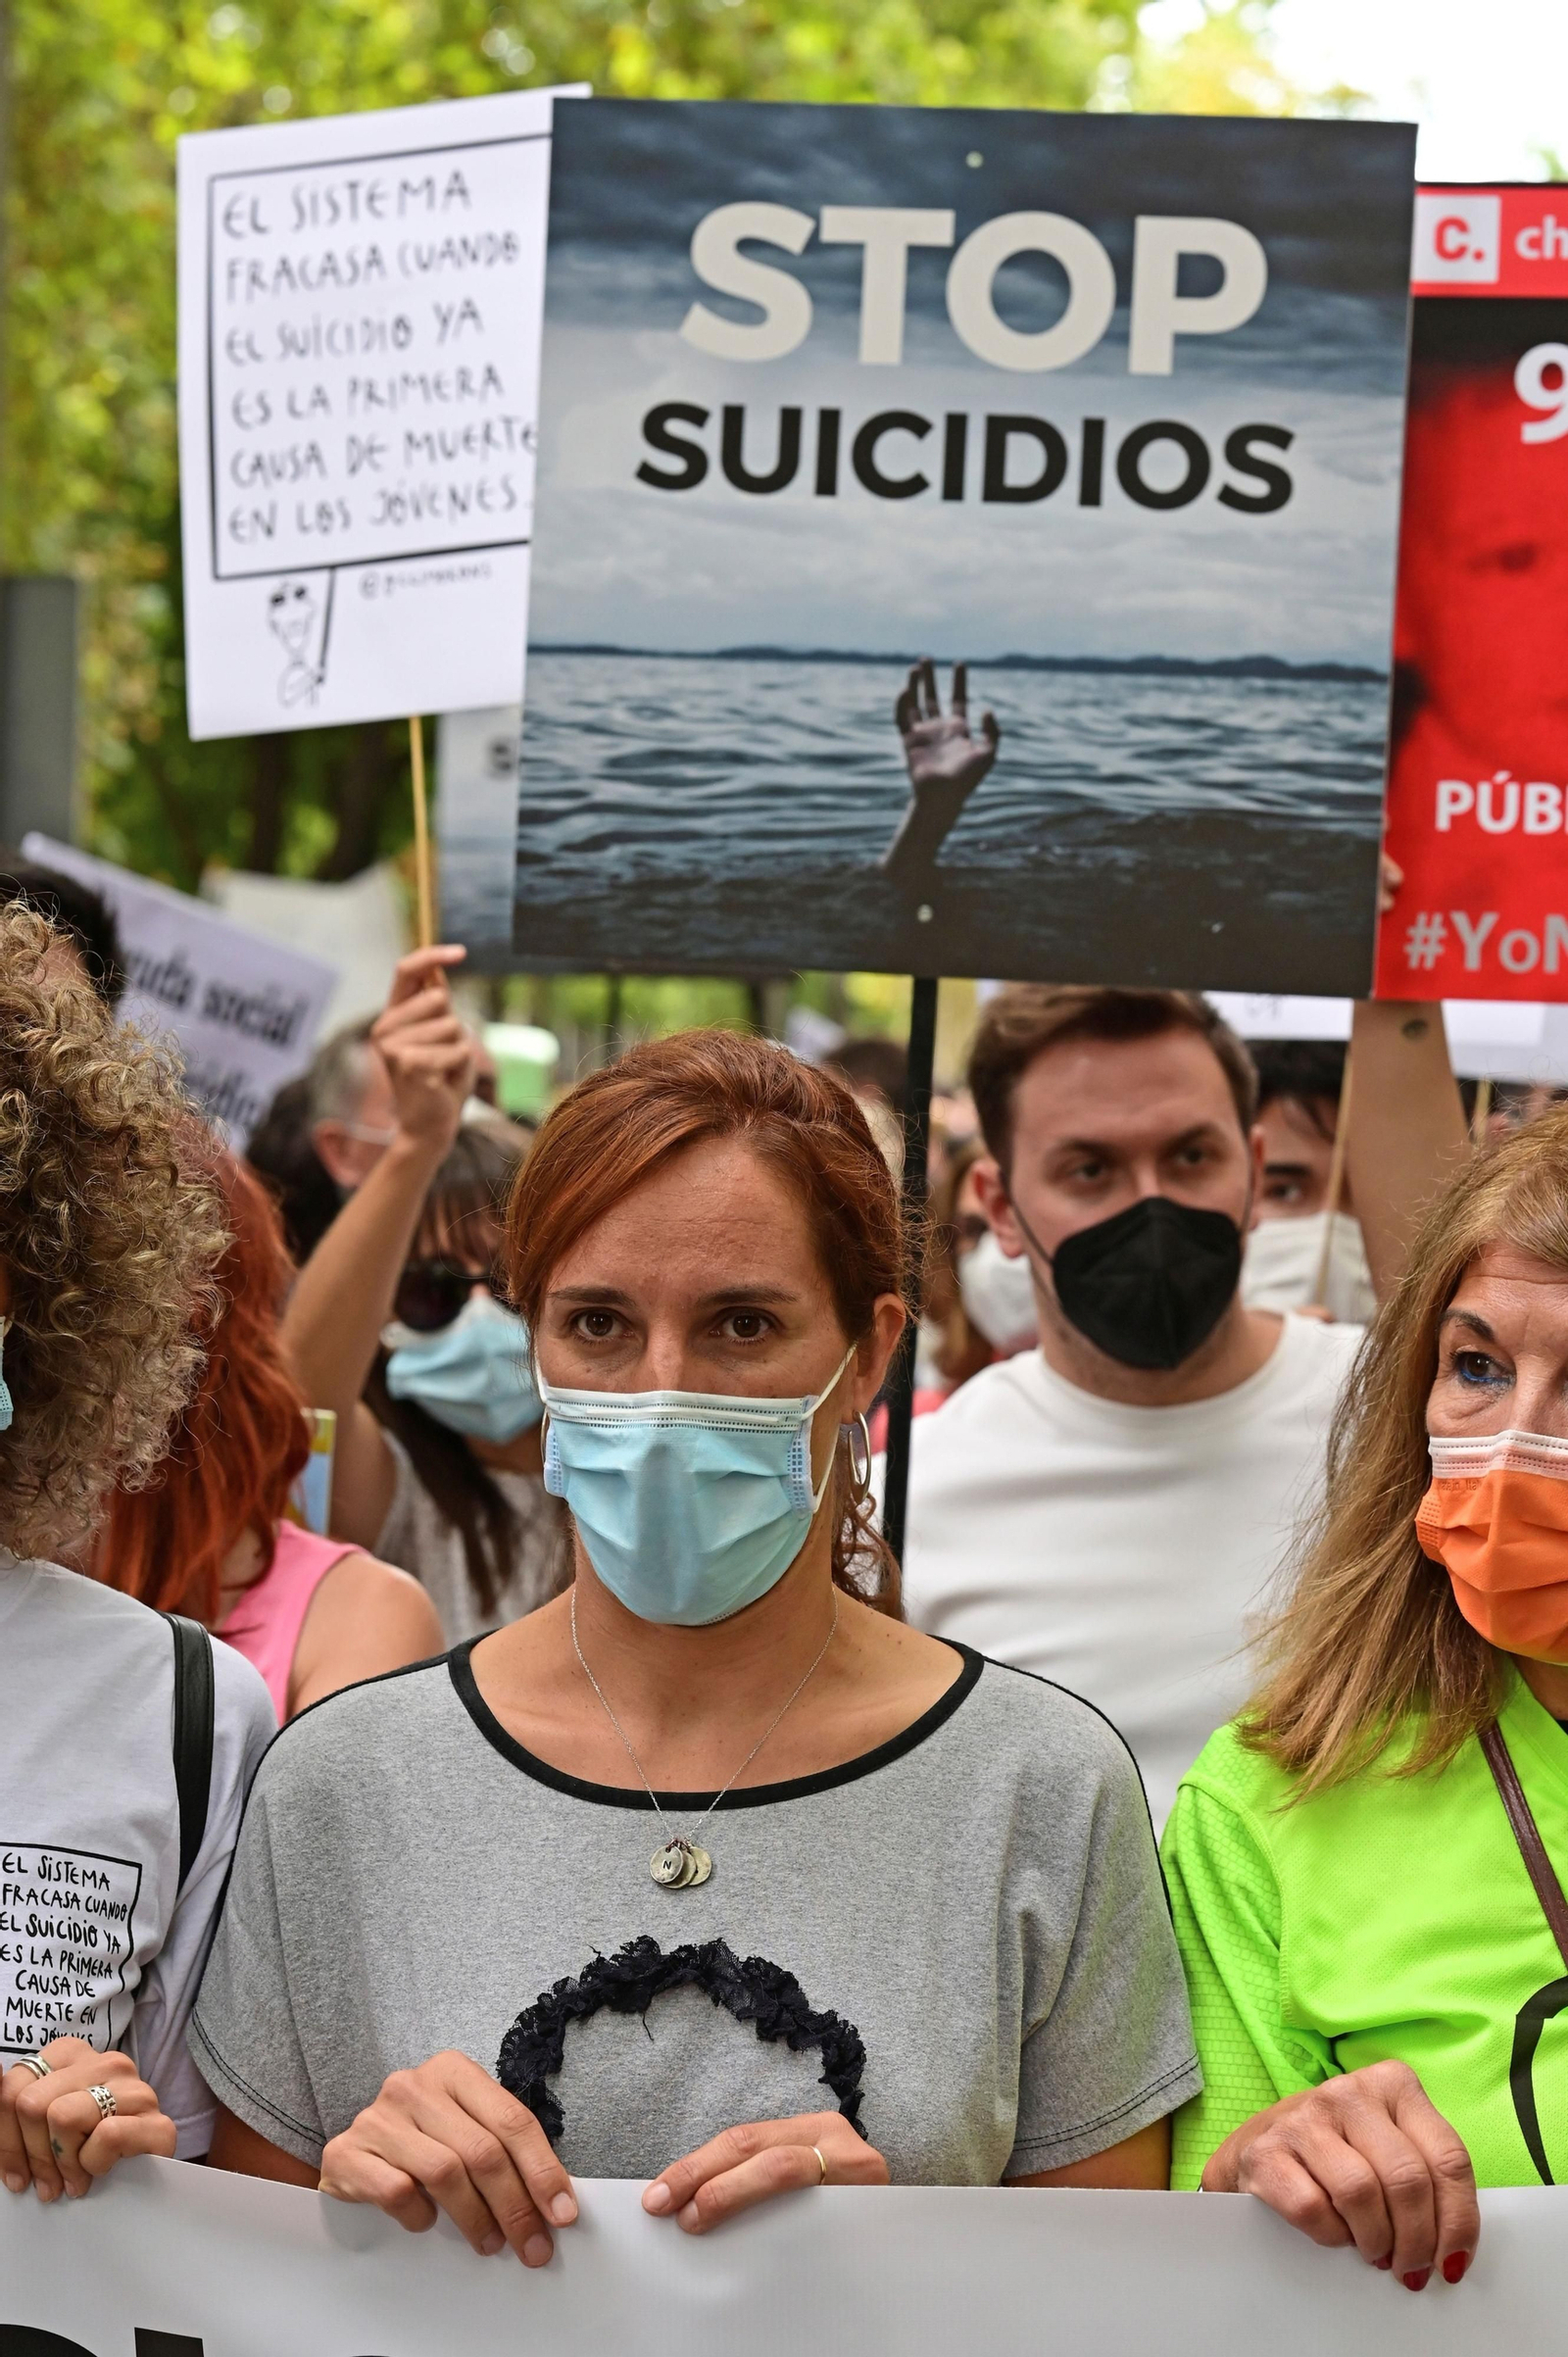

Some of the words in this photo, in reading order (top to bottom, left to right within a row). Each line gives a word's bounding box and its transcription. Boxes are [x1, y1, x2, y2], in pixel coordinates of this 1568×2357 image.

[222, 191, 270, 238] EL
[290, 169, 472, 233] SISTEMA
[225, 243, 388, 305] FRACASA
[397, 228, 520, 279] CUANDO
[679, 201, 1268, 375] STOP
[225, 326, 265, 367] EL
[276, 312, 415, 362] SUICIDIO
[431, 296, 485, 347] YA
[231, 388, 272, 431] ES
[286, 382, 332, 420] LA
[346, 363, 506, 418] PRIMERA
[229, 440, 328, 490] CAUSA
[346, 431, 389, 477] DE
[403, 413, 536, 469] MUERTE
[635, 402, 1296, 515] SUICIDIOS
[227, 500, 278, 545] EN
[296, 496, 352, 537] LOS
[1434, 770, 1568, 835] PÚB
[2, 1852, 28, 1874] EL
[3, 1883, 81, 1911] FRACASA
[84, 1895, 128, 1922] CUANDO
[0, 1911, 22, 1933] EL
[103, 1929, 122, 1955] YA
[0, 1943, 23, 1964] ES
[30, 1945, 53, 1968] LA
[6, 1995, 74, 2023] MUERTE
[79, 2005, 99, 2026] EN
[16, 1969, 72, 1997] CAUSA
[75, 1980, 96, 1998] DE
[4, 2022, 33, 2044] LOS
